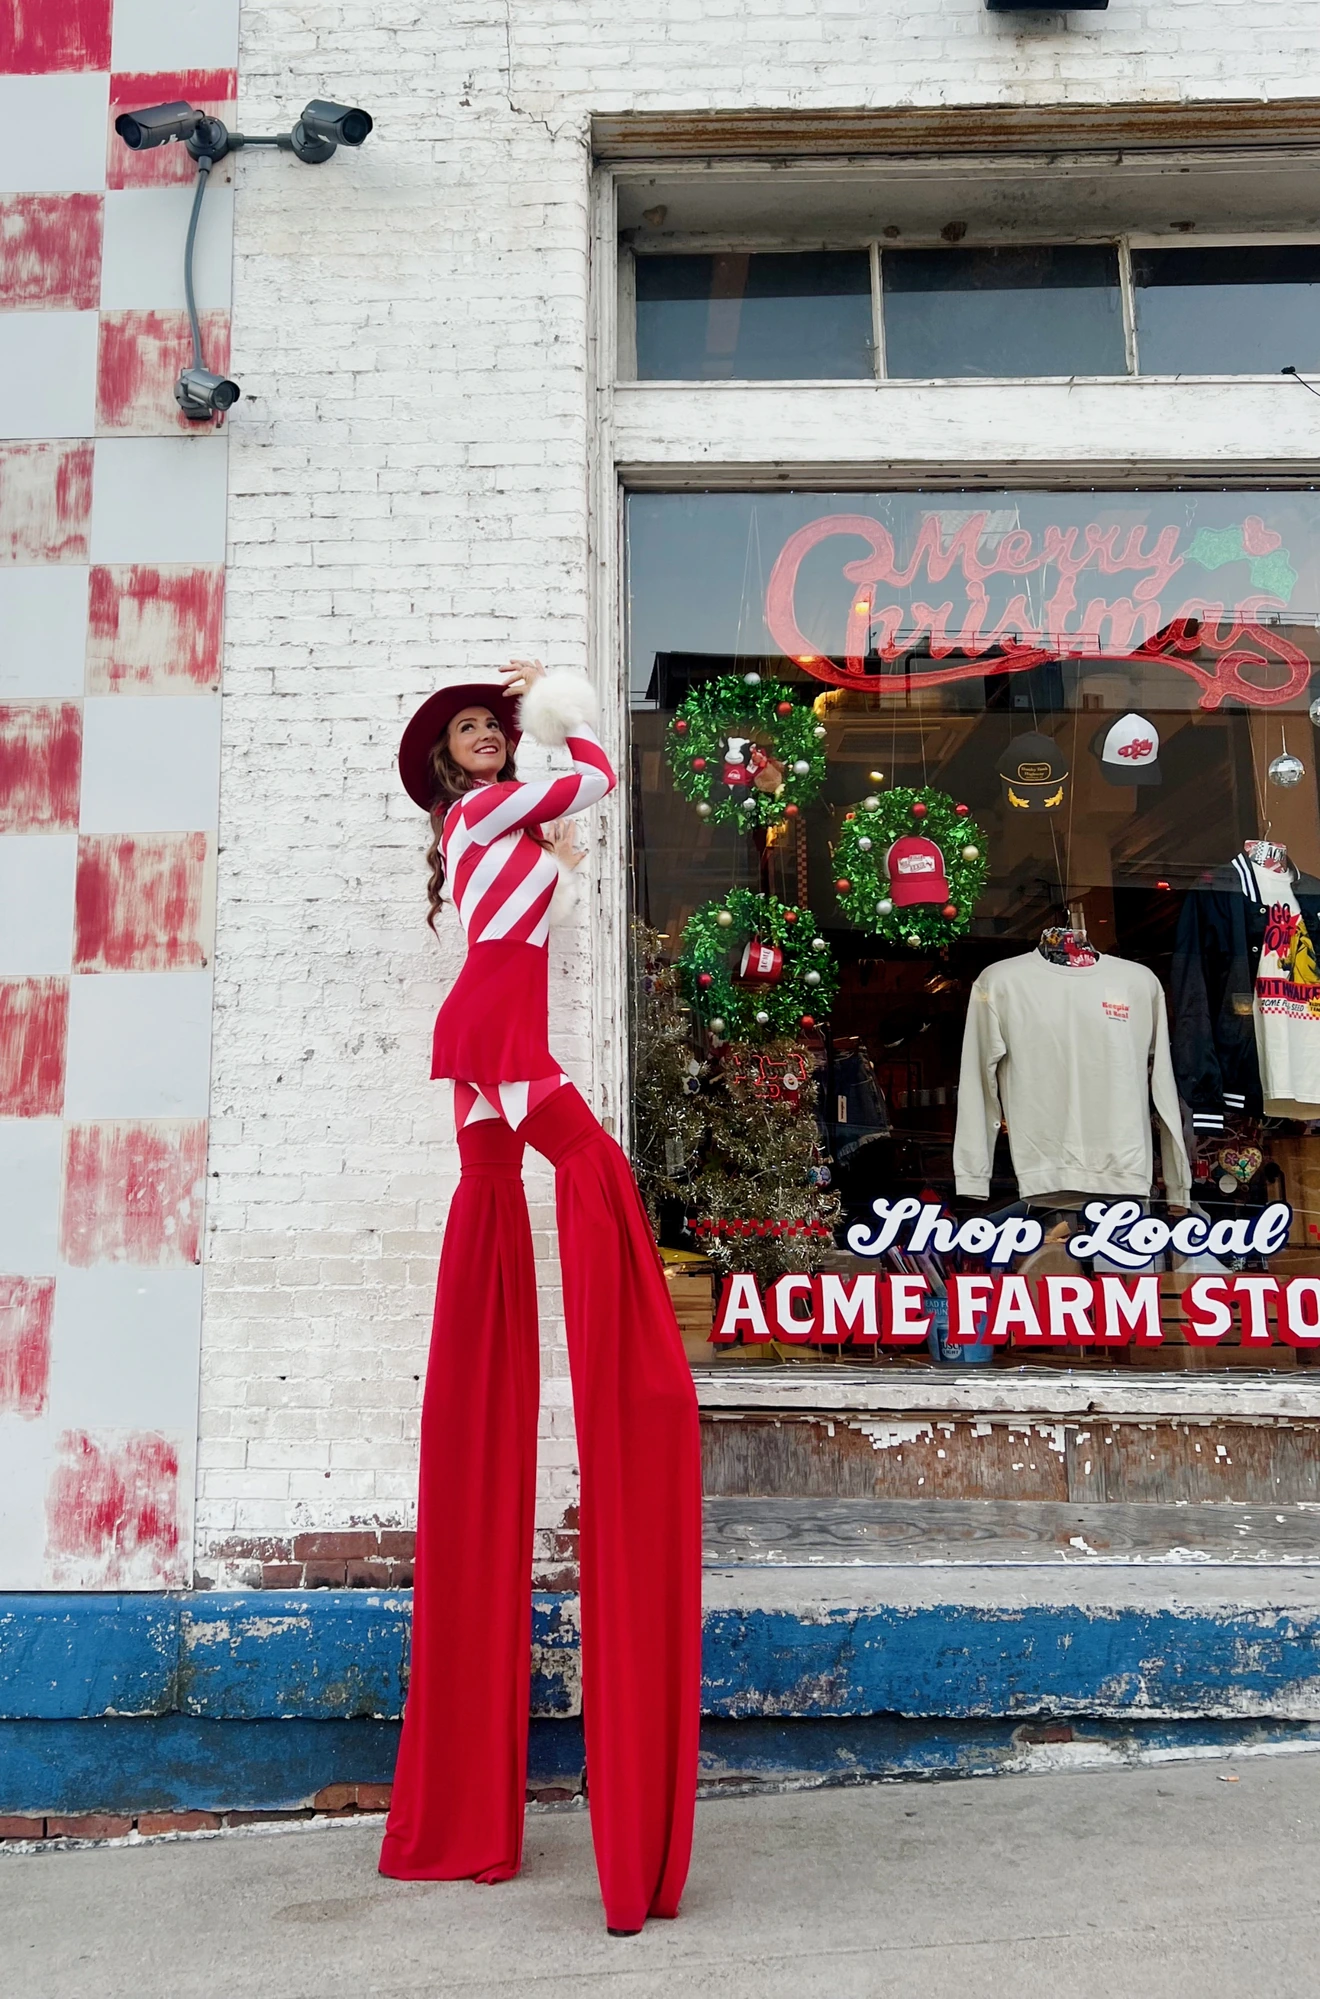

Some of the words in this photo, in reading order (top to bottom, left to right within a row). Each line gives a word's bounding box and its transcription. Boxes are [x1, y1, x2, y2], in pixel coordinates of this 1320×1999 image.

[900, 513, 1184, 600] Merry
[767, 513, 1310, 710] Christmas
[760, 950, 771, 970] ACME
[1113, 1010, 1129, 1019] Real
[846, 1196, 1043, 1264] Shop
[1068, 1200, 1291, 1267] Local
[712, 1273, 934, 1343] ACME
[950, 1274, 1165, 1344] FARM
[1184, 1275, 1320, 1345] STO
